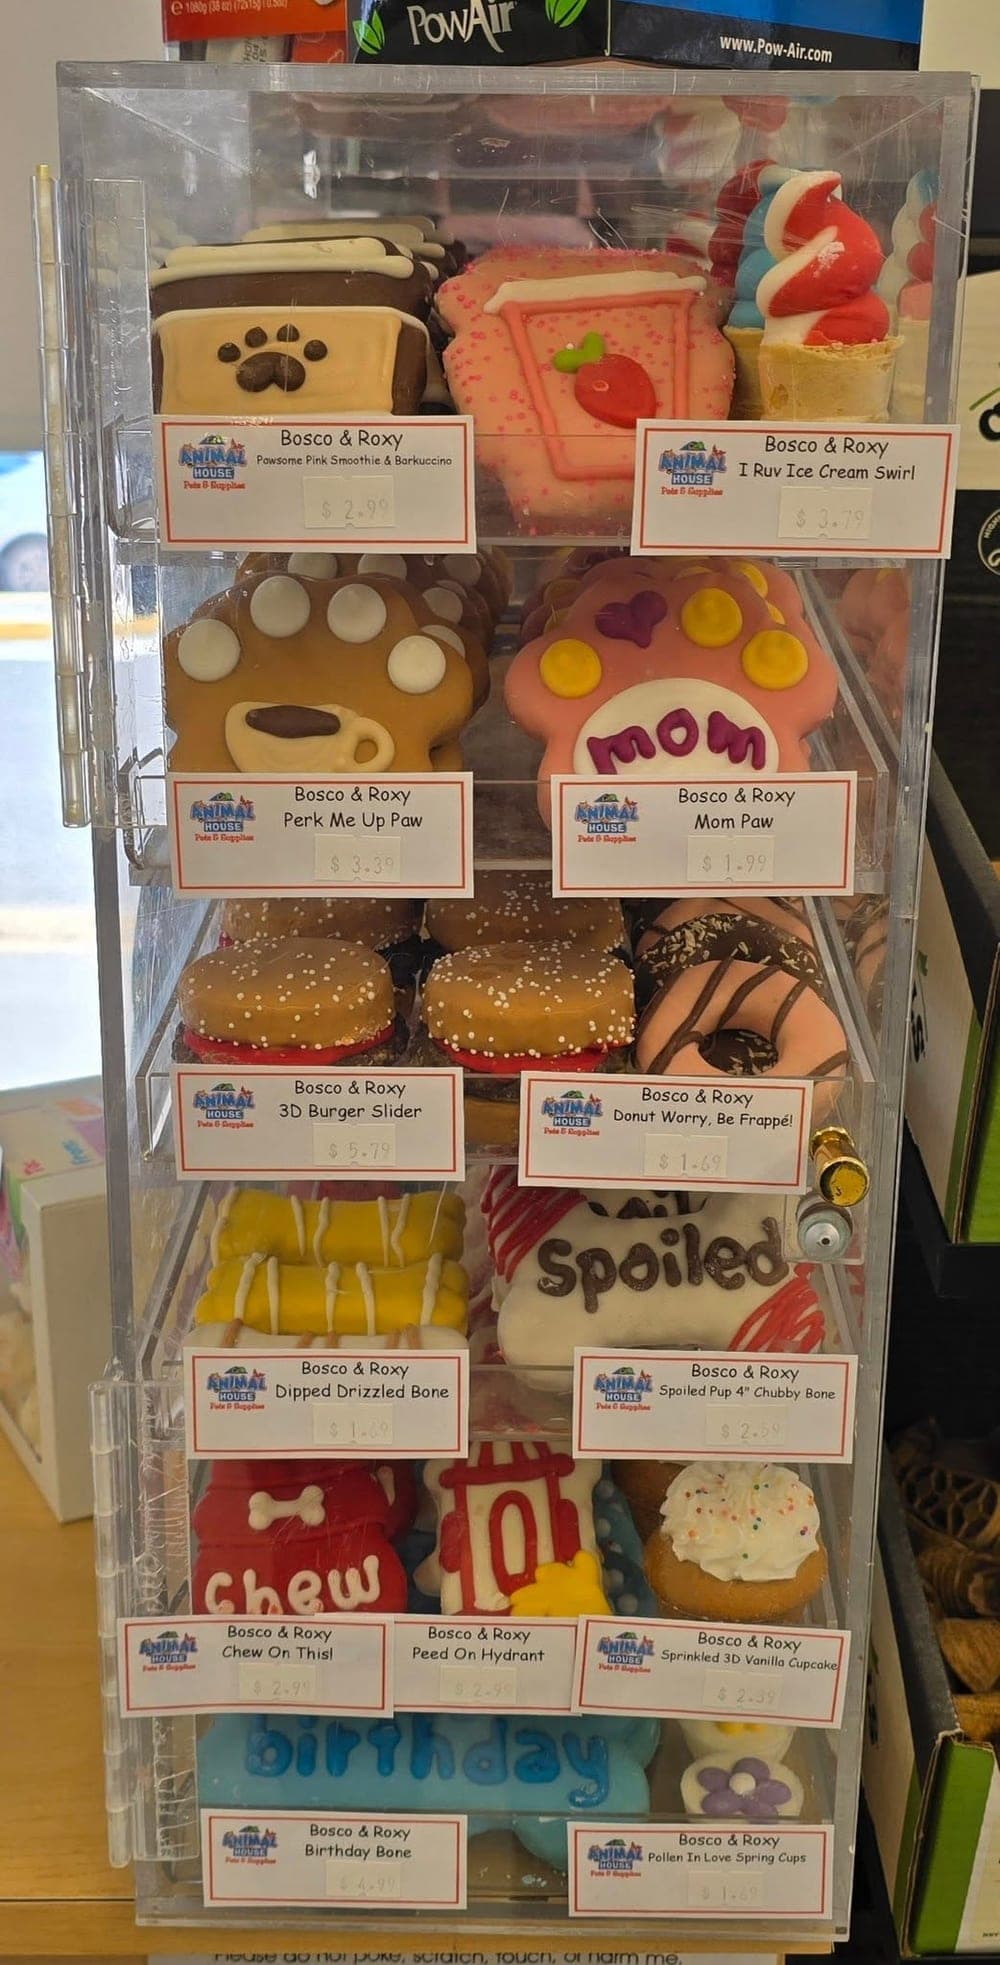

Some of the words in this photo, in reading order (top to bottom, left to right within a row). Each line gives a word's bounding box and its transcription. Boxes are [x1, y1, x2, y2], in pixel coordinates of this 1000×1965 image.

[408, 0, 517, 53] PowAir
[720, 35, 832, 63] www.Pow-Air.com
[282, 430, 332, 446] Bosco
[340, 430, 352, 446] &
[359, 430, 403, 451] Roxy
[766, 434, 818, 452] Bosco
[824, 437, 836, 453] &
[843, 437, 888, 459] Roxy
[179, 446, 247, 466] ANIMAL
[257, 455, 302, 464] Pawsome
[306, 455, 327, 464] Pink
[331, 455, 380, 464] Smoothie
[384, 456, 391, 465] &
[395, 455, 451, 465] Barkuccino
[658, 452, 727, 472] ANIMAL
[193, 467, 234, 479] HOUSE
[672, 473, 712, 484] HOUSE
[739, 463, 748, 476] I
[754, 463, 782, 477] Ruv
[787, 464, 813, 478] Ice
[819, 464, 868, 479] Cream
[875, 465, 915, 480] Swirl
[322, 501, 331, 520] $
[345, 497, 388, 520] 2.99
[796, 508, 805, 528] $
[819, 508, 864, 529] 3.79
[296, 786, 344, 801] Bosco
[351, 786, 362, 801] &
[369, 786, 410, 806] Roxy
[679, 788, 727, 803] Bosco
[735, 788, 746, 803] &
[753, 788, 795, 807] Roxy
[190, 801, 256, 821] ANIMAL
[575, 804, 640, 822] ANIMAL
[203, 821, 243, 832] HOUSE
[285, 812, 323, 827] Perk
[330, 812, 355, 827] Me
[363, 813, 385, 832] Up
[392, 812, 422, 827] Paw
[587, 823, 626, 833] HOUSE
[695, 814, 735, 829] Mom
[742, 814, 773, 828] Paw
[331, 856, 340, 873] $
[353, 855, 394, 874] 3.39
[702, 855, 711, 872] $
[724, 854, 767, 873] 1.99
[295, 1080, 342, 1094] Bosco
[349, 1081, 360, 1094] &
[366, 1081, 406, 1099] Roxy
[642, 1087, 688, 1102] Bosco
[695, 1087, 707, 1103] &
[713, 1088, 754, 1108] Roxy
[192, 1093, 255, 1110] ANIMAL
[541, 1100, 603, 1118] ANIMAL
[206, 1110, 244, 1119] HOUSE
[280, 1104, 301, 1118] 3D
[309, 1104, 365, 1121] Burger
[372, 1104, 422, 1118] Slider
[614, 1109, 656, 1122] Donut
[661, 1111, 711, 1127] Worry,
[717, 1113, 734, 1125] Be
[740, 1114, 792, 1129] Frappé!
[553, 1117, 591, 1127] HOUSE
[328, 1143, 337, 1159] $
[350, 1142, 392, 1160] 5.79
[659, 1153, 669, 1170] $
[680, 1153, 721, 1172] 1.69
[302, 1361, 347, 1374] Bosco
[353, 1362, 364, 1375] &
[370, 1362, 409, 1379] Roxy
[692, 1364, 737, 1378] Bosco
[743, 1365, 754, 1379] &
[760, 1365, 799, 1383] Roxy
[206, 1376, 268, 1393] ANIMAL
[276, 1384, 330, 1401] Dipped
[338, 1384, 404, 1398] Drizzled
[412, 1385, 449, 1398] Bone
[593, 1376, 653, 1393] ANIMAL
[659, 1385, 706, 1398] Spoiled
[710, 1386, 731, 1399] Pup
[736, 1386, 749, 1396] 4"
[754, 1387, 800, 1401] Chubby
[806, 1388, 835, 1399] Bone
[219, 1392, 256, 1401] HOUSE
[605, 1392, 642, 1402] HOUSE
[329, 1422, 338, 1438] $
[228, 1625, 271, 1637] Bosco
[278, 1626, 288, 1638] &
[294, 1625, 332, 1643] Roxy
[429, 1626, 471, 1639] Bosco
[478, 1626, 487, 1640] &
[494, 1627, 530, 1644] Roxy
[698, 1631, 742, 1646] Bosco
[748, 1635, 757, 1648] &
[764, 1636, 802, 1653] Roxy
[223, 1645, 262, 1657] Chew
[269, 1647, 289, 1658] On
[413, 1647, 448, 1659] Peed
[454, 1648, 476, 1659] On
[482, 1648, 544, 1664] Hydrant
[661, 1650, 719, 1662] Sprinkled
[725, 1654, 740, 1663] 3D
[746, 1655, 784, 1666] Vanilla
[789, 1657, 839, 1672] Cupcake
[253, 1680, 260, 1696] $
[717, 1687, 726, 1702] $
[243, 1713, 609, 1809] birthday
[311, 1824, 352, 1836] Bosco
[359, 1826, 368, 1837] &
[374, 1826, 410, 1841] Roxy
[678, 1833, 723, 1845] Bosco
[727, 1833, 739, 1845] &
[742, 1833, 781, 1848] Roxy
[306, 1844, 370, 1860] Birthday
[377, 1846, 411, 1857] Bone
[649, 1853, 682, 1862] Pollen
[688, 1853, 700, 1862] In
[705, 1853, 730, 1862] Love
[736, 1853, 774, 1864] Spring
[779, 1853, 805, 1864] Cups
